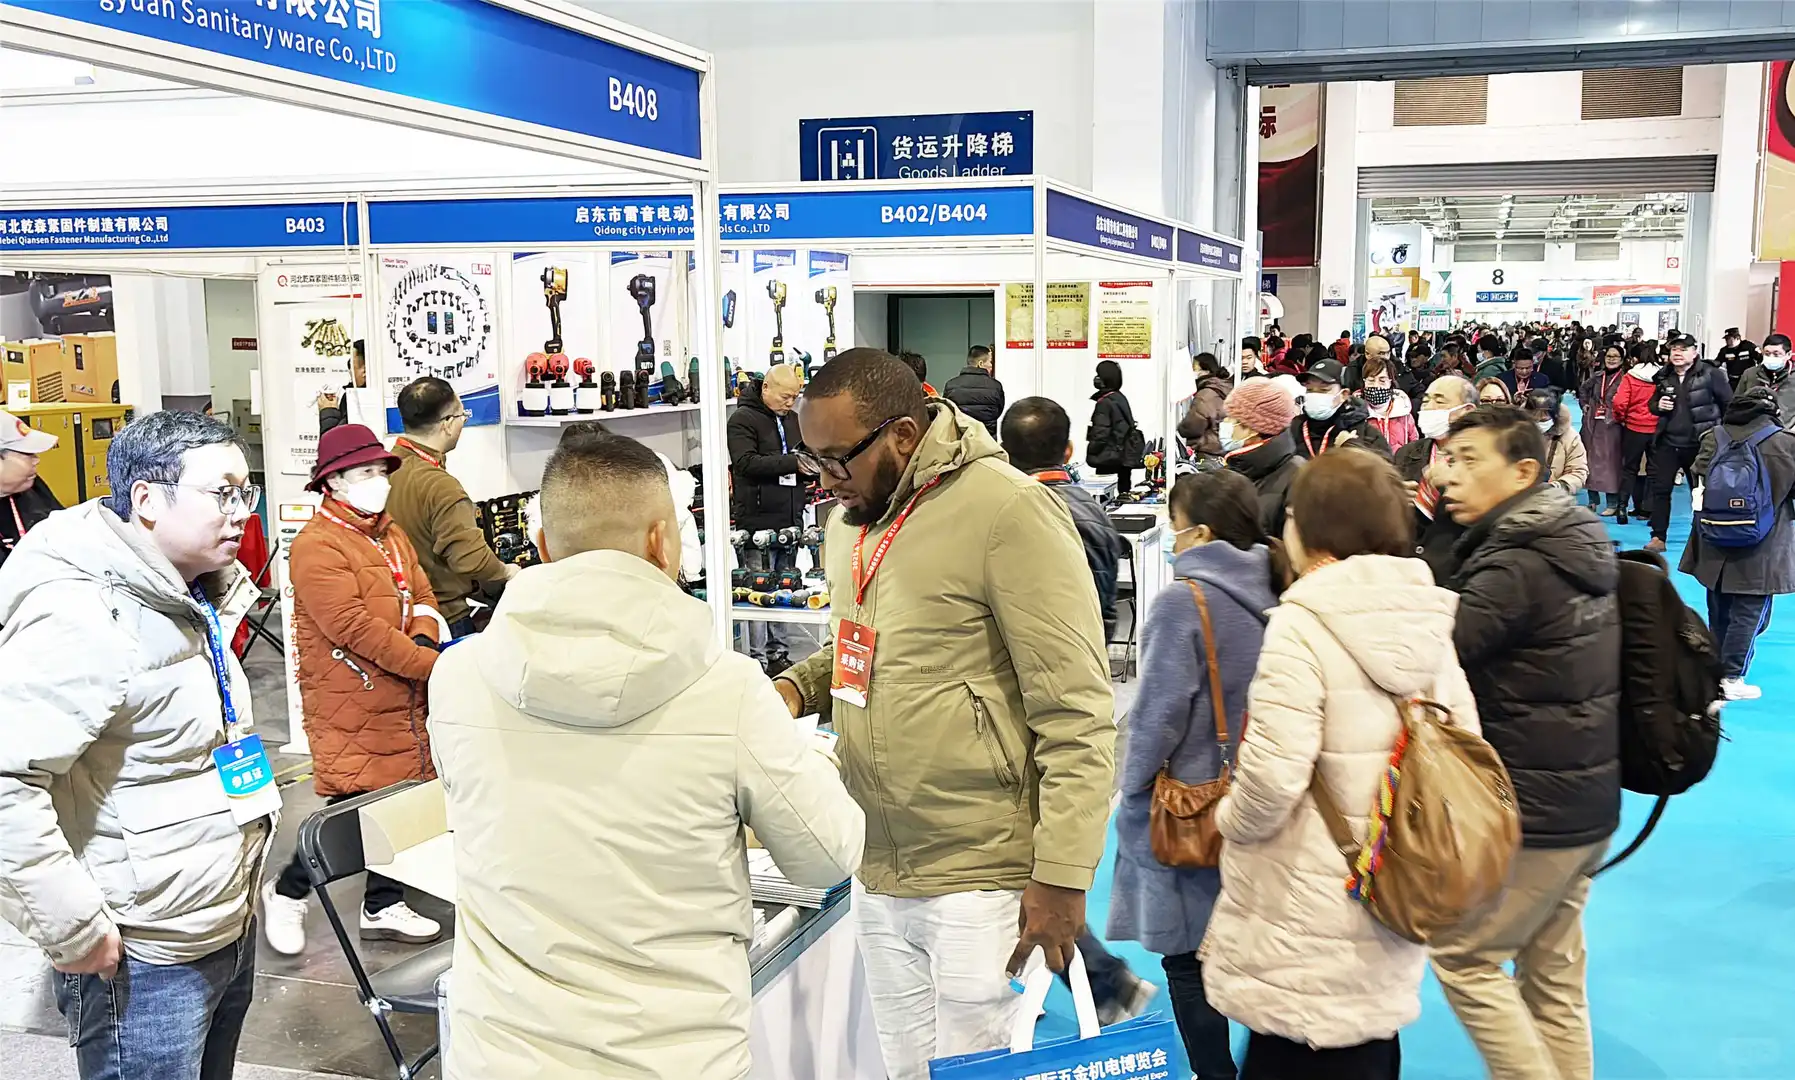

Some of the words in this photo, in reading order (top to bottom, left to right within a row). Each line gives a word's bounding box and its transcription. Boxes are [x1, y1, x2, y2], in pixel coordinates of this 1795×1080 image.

[256, 0, 382, 39] 限公司
[182, 0, 273, 49] Sanitary
[278, 30, 325, 57] ware
[330, 37, 397, 74] Co.,LTD
[608, 76, 659, 122] B408
[892, 131, 1015, 160] 货运升降梯
[898, 164, 948, 179] Goods
[881, 203, 988, 226] B402/B404
[285, 217, 326, 234] B403
[593, 225, 628, 236] Qidong
[629, 225, 647, 236] city
[648, 224, 676, 236] Leiyin
[734, 223, 771, 235] Co.,LTD
[0, 236, 18, 245] ebei
[19, 235, 50, 246] Qiansen
[50, 235, 83, 244] Fastener
[84, 234, 140, 245] Manufacturing
[140, 234, 169, 244] Co.,Ltd
[1492, 268, 1505, 285] 8
